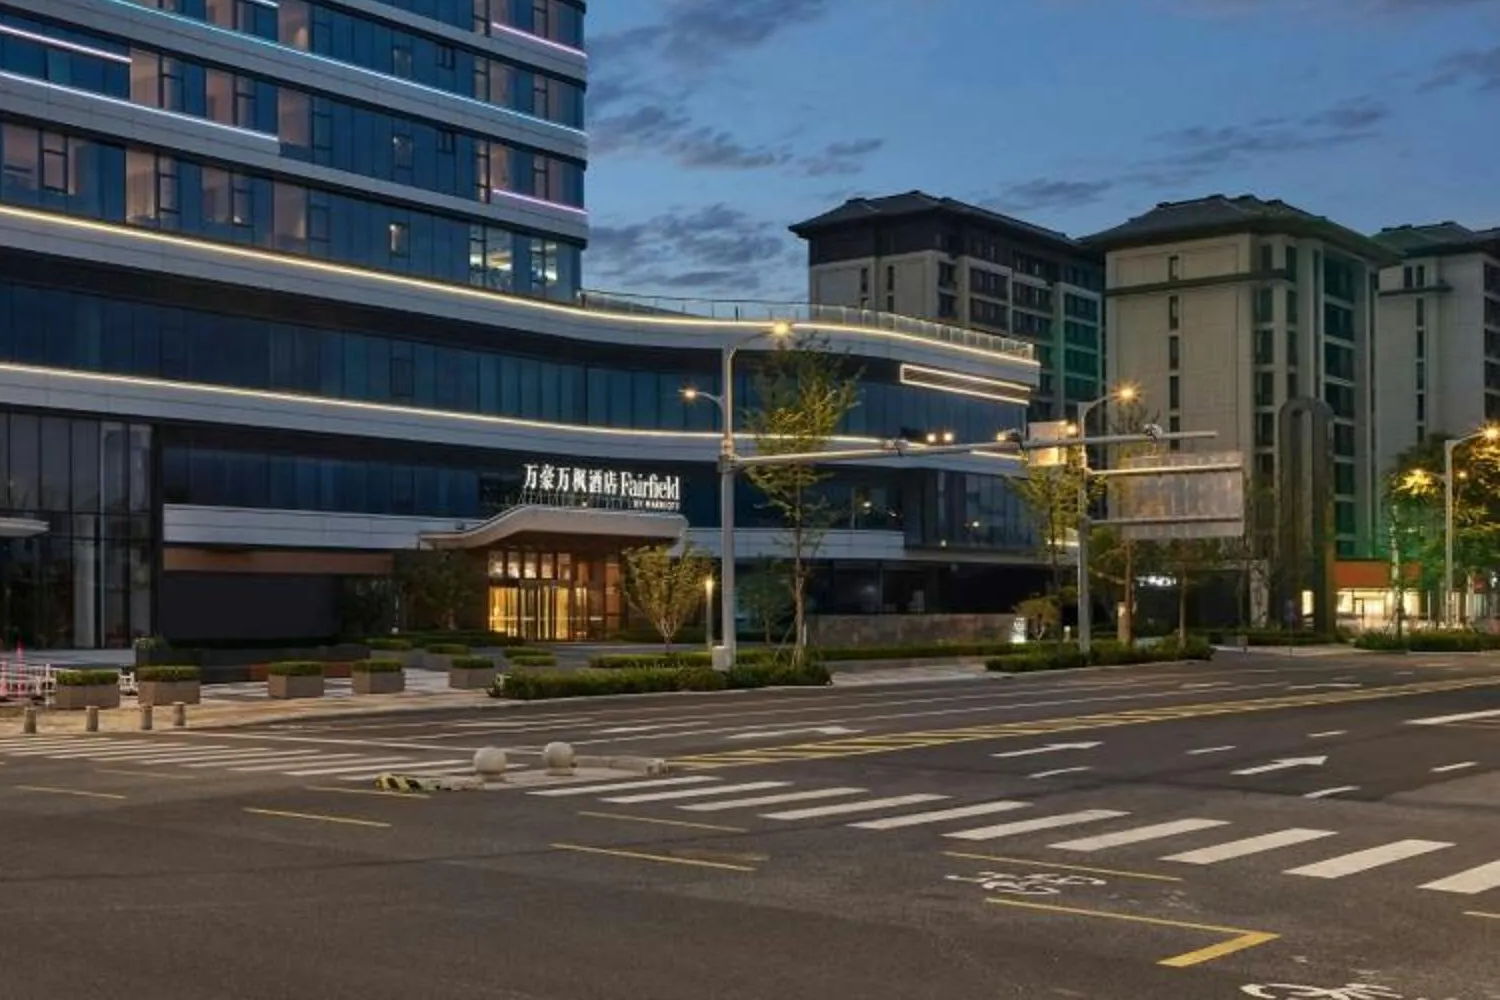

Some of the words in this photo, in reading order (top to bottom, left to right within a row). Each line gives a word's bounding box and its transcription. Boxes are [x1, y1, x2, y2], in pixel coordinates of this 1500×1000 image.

[523, 463, 618, 495] 万豪万枫酒店
[621, 471, 680, 500] Fairfield
